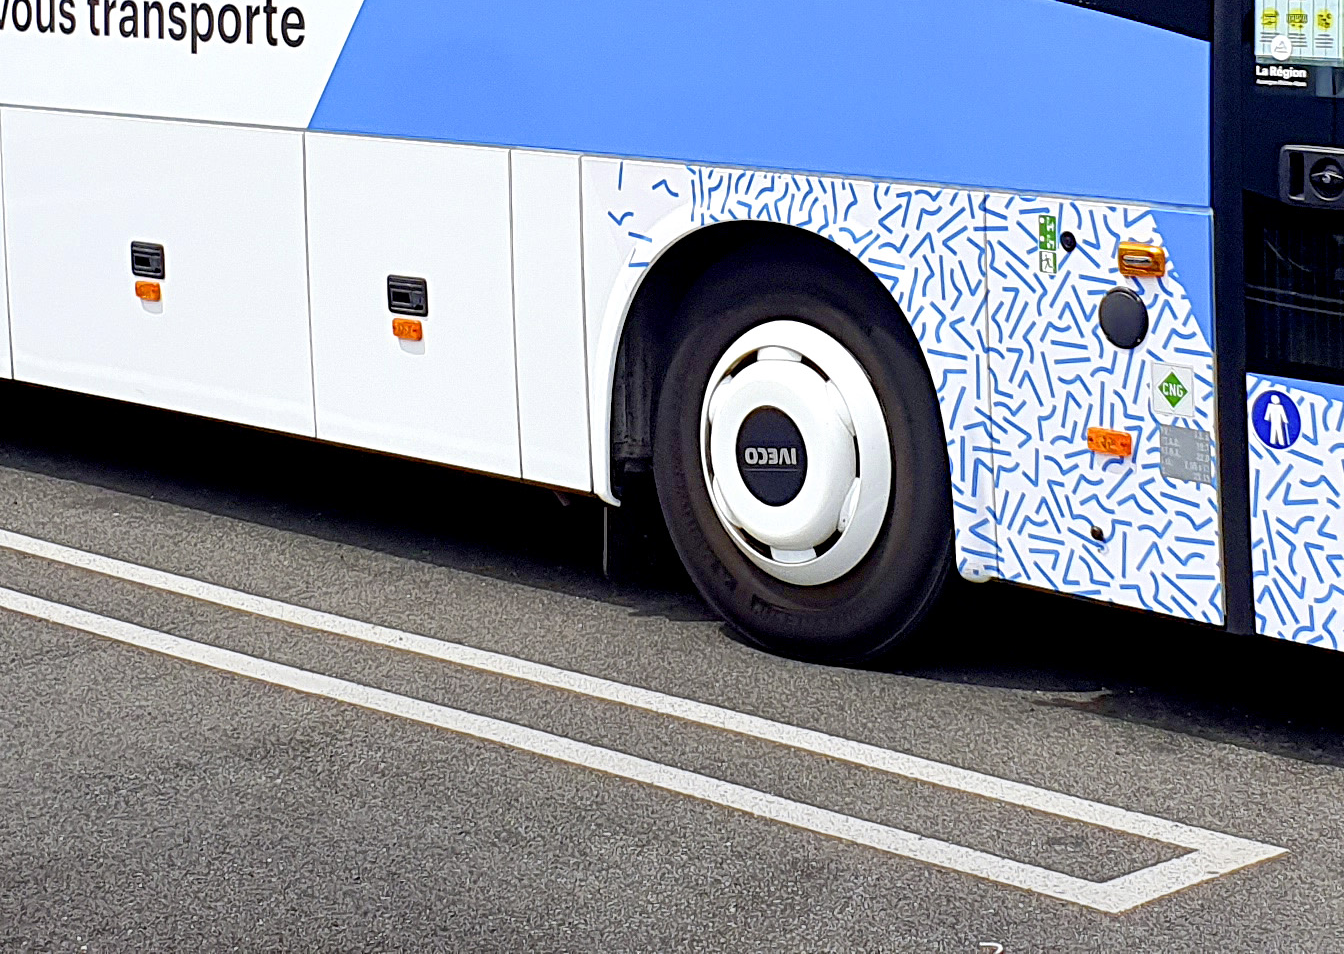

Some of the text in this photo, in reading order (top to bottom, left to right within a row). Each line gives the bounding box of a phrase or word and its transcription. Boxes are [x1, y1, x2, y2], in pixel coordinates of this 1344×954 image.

[1256, 65, 1307, 79] La Région
[1162, 382, 1185, 398] CNG
[745, 447, 797, 465] IVECO
